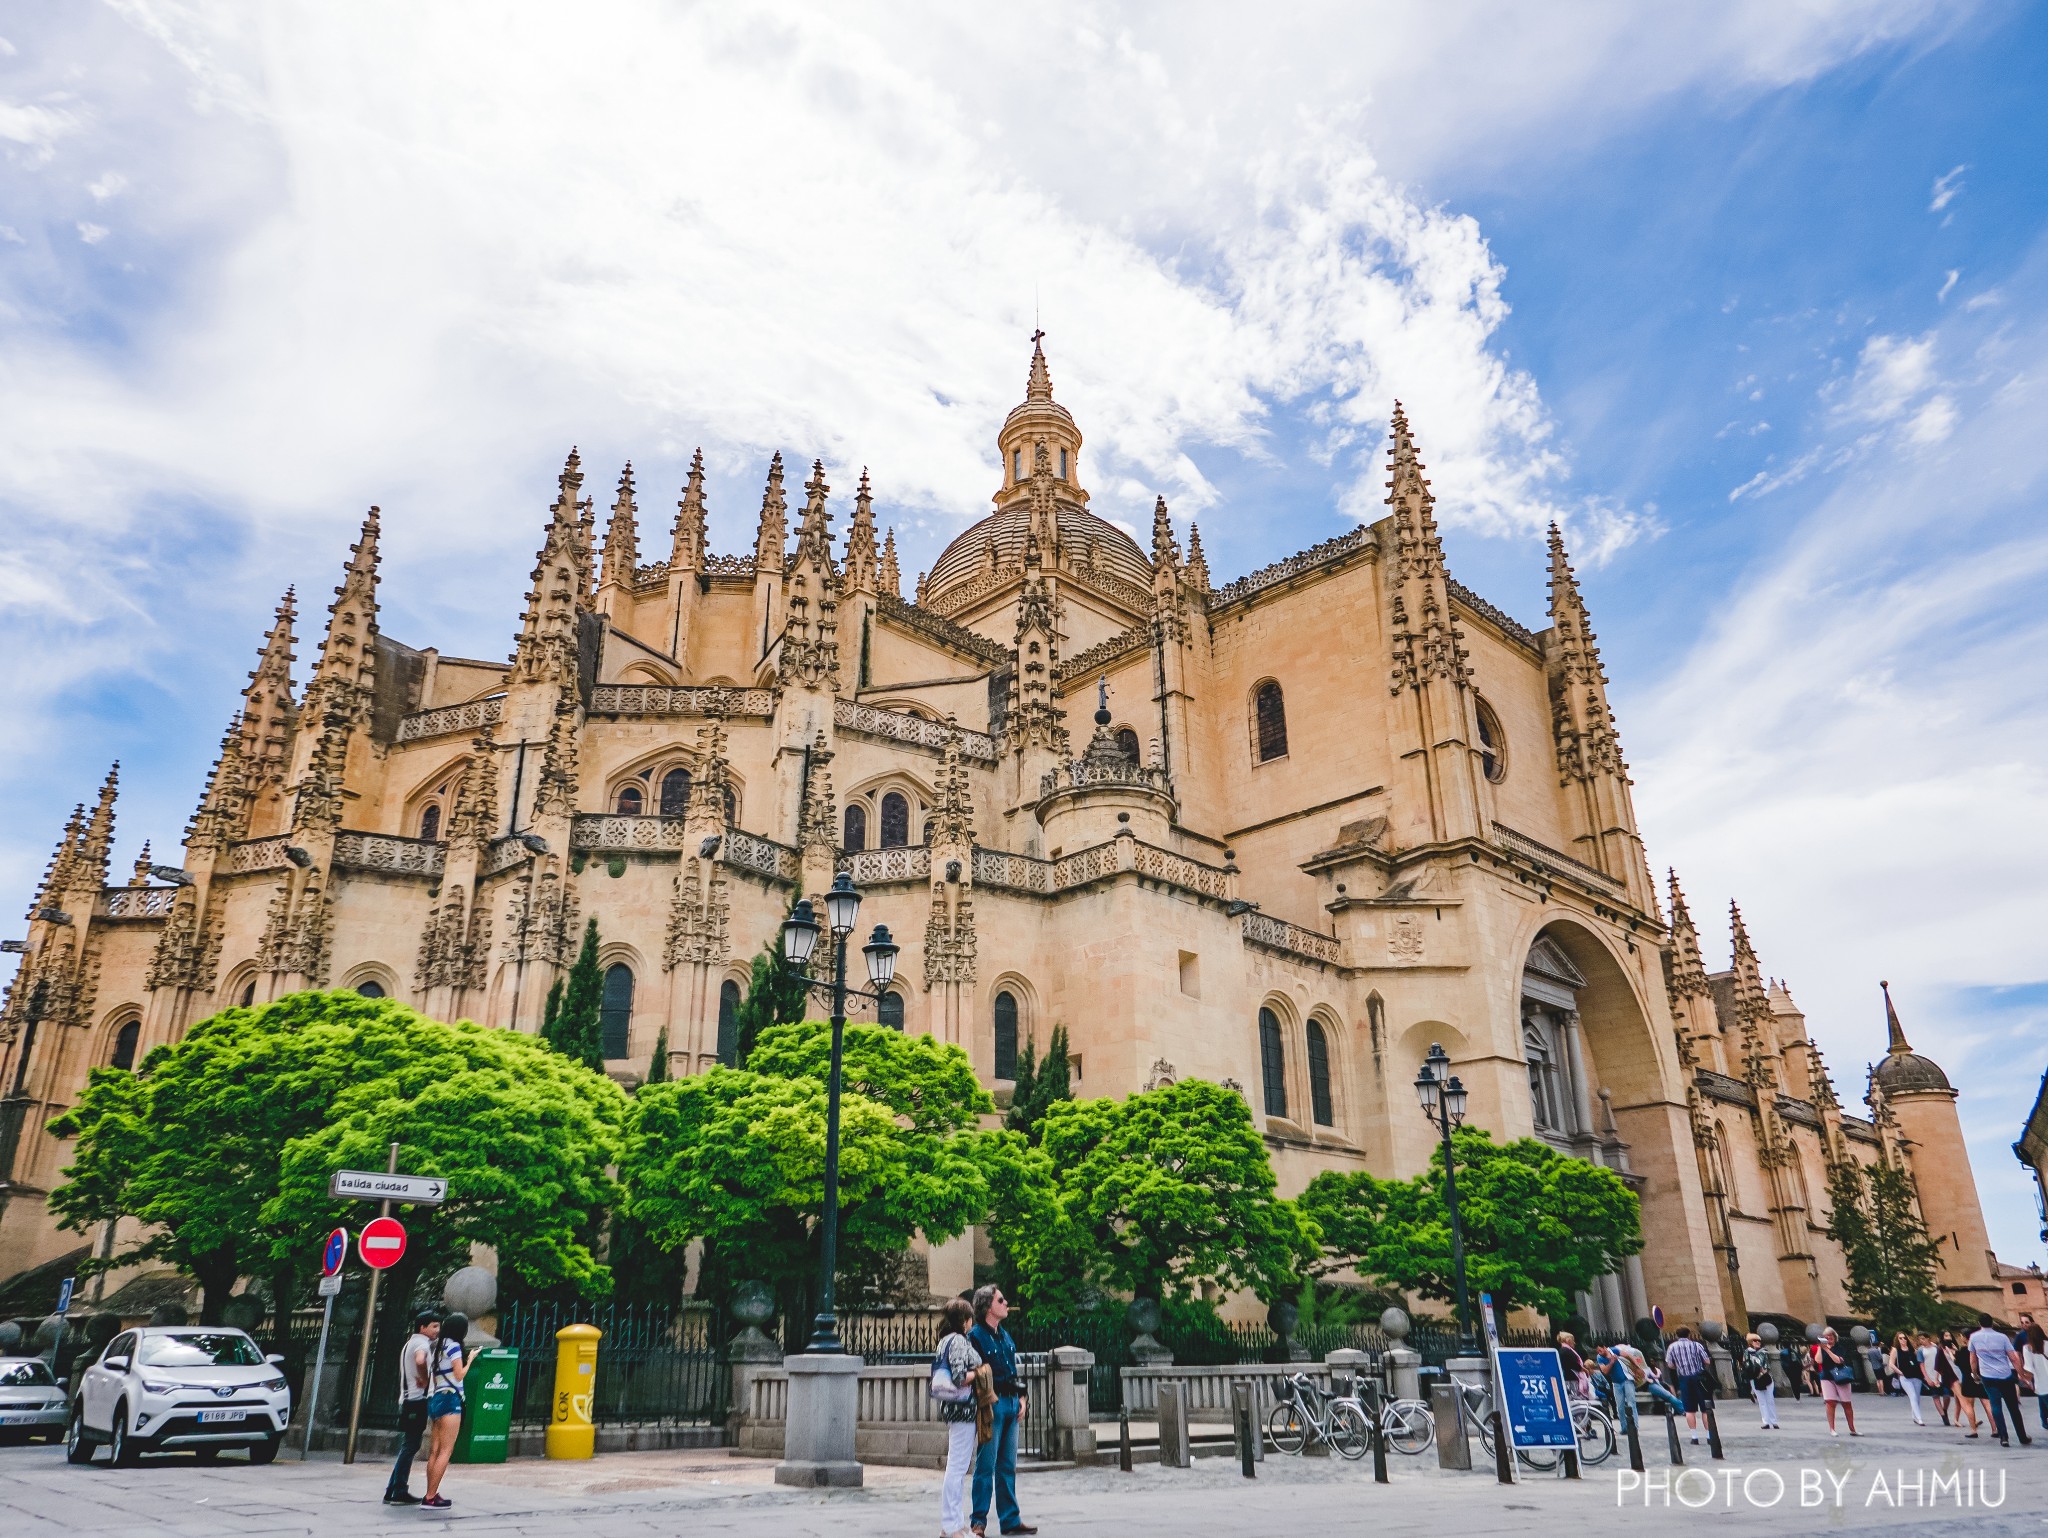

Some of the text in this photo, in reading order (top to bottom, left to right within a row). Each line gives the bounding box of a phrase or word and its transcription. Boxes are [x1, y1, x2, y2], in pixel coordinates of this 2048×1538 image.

[341, 1179, 409, 1192] salida ciudad
[59, 1283, 69, 1308] P
[1520, 1379, 1548, 1394] 25€
